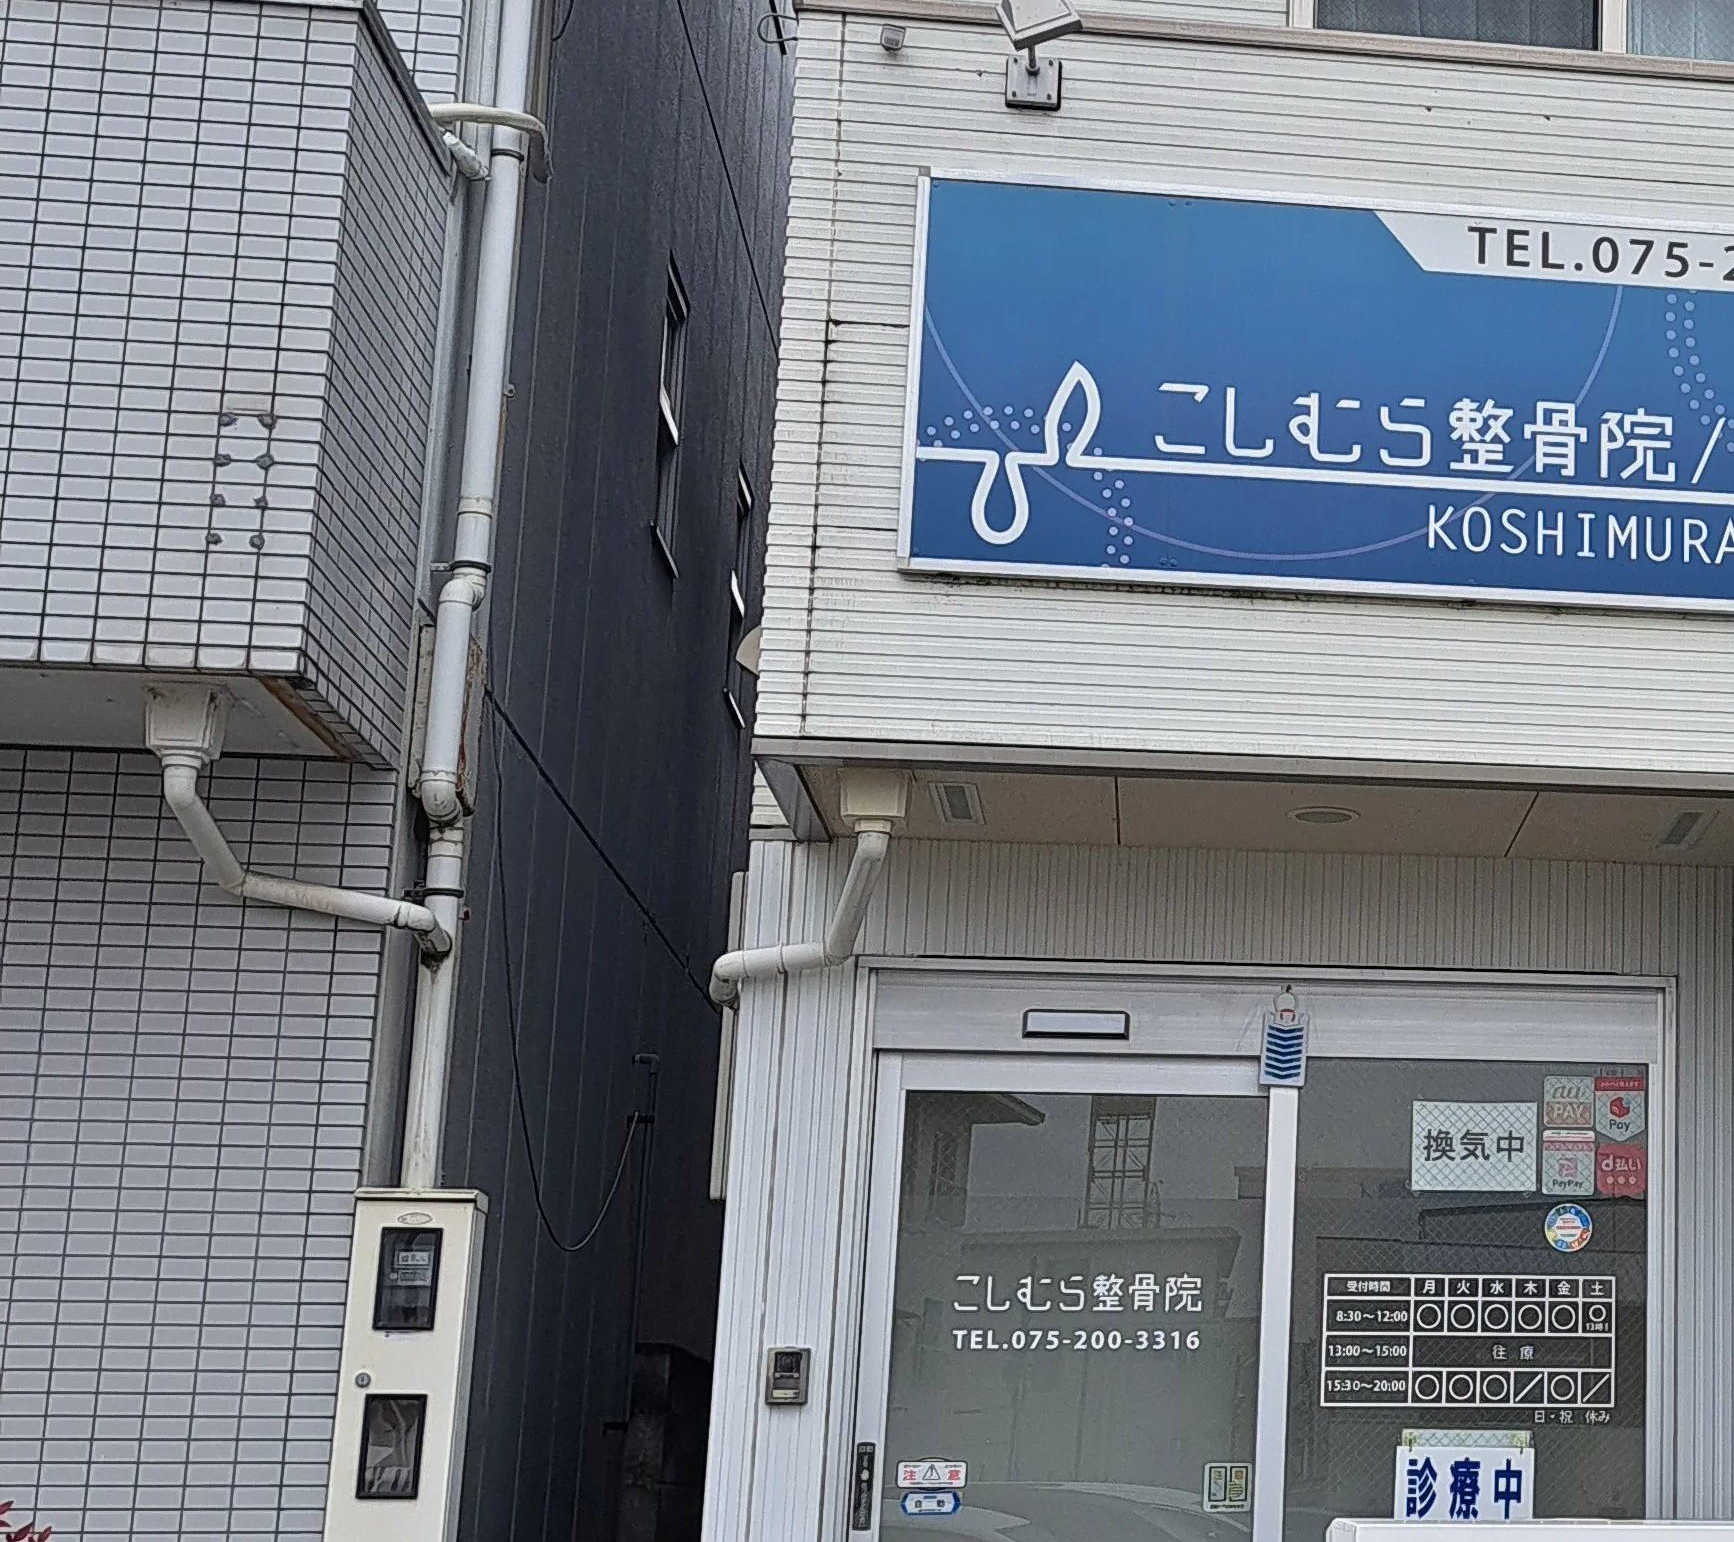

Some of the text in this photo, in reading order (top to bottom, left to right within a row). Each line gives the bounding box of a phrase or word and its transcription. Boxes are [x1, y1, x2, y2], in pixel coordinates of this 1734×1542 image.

[1553, 1104, 1584, 1119] PAY
[1610, 1119, 1631, 1132] Pay
[1424, 1130, 1525, 1163] 換気中
[1552, 1179, 1585, 1190] PayPay
[953, 1274, 1203, 1313] こしむら整骨院
[1346, 1280, 1605, 1296] 受付時間 月 火 水 木 金 土
[953, 1329, 1201, 1351] TEL.075-200-3316
[1585, 1410, 1611, 1425] 休み
[1406, 1457, 1523, 1520] 診療中
